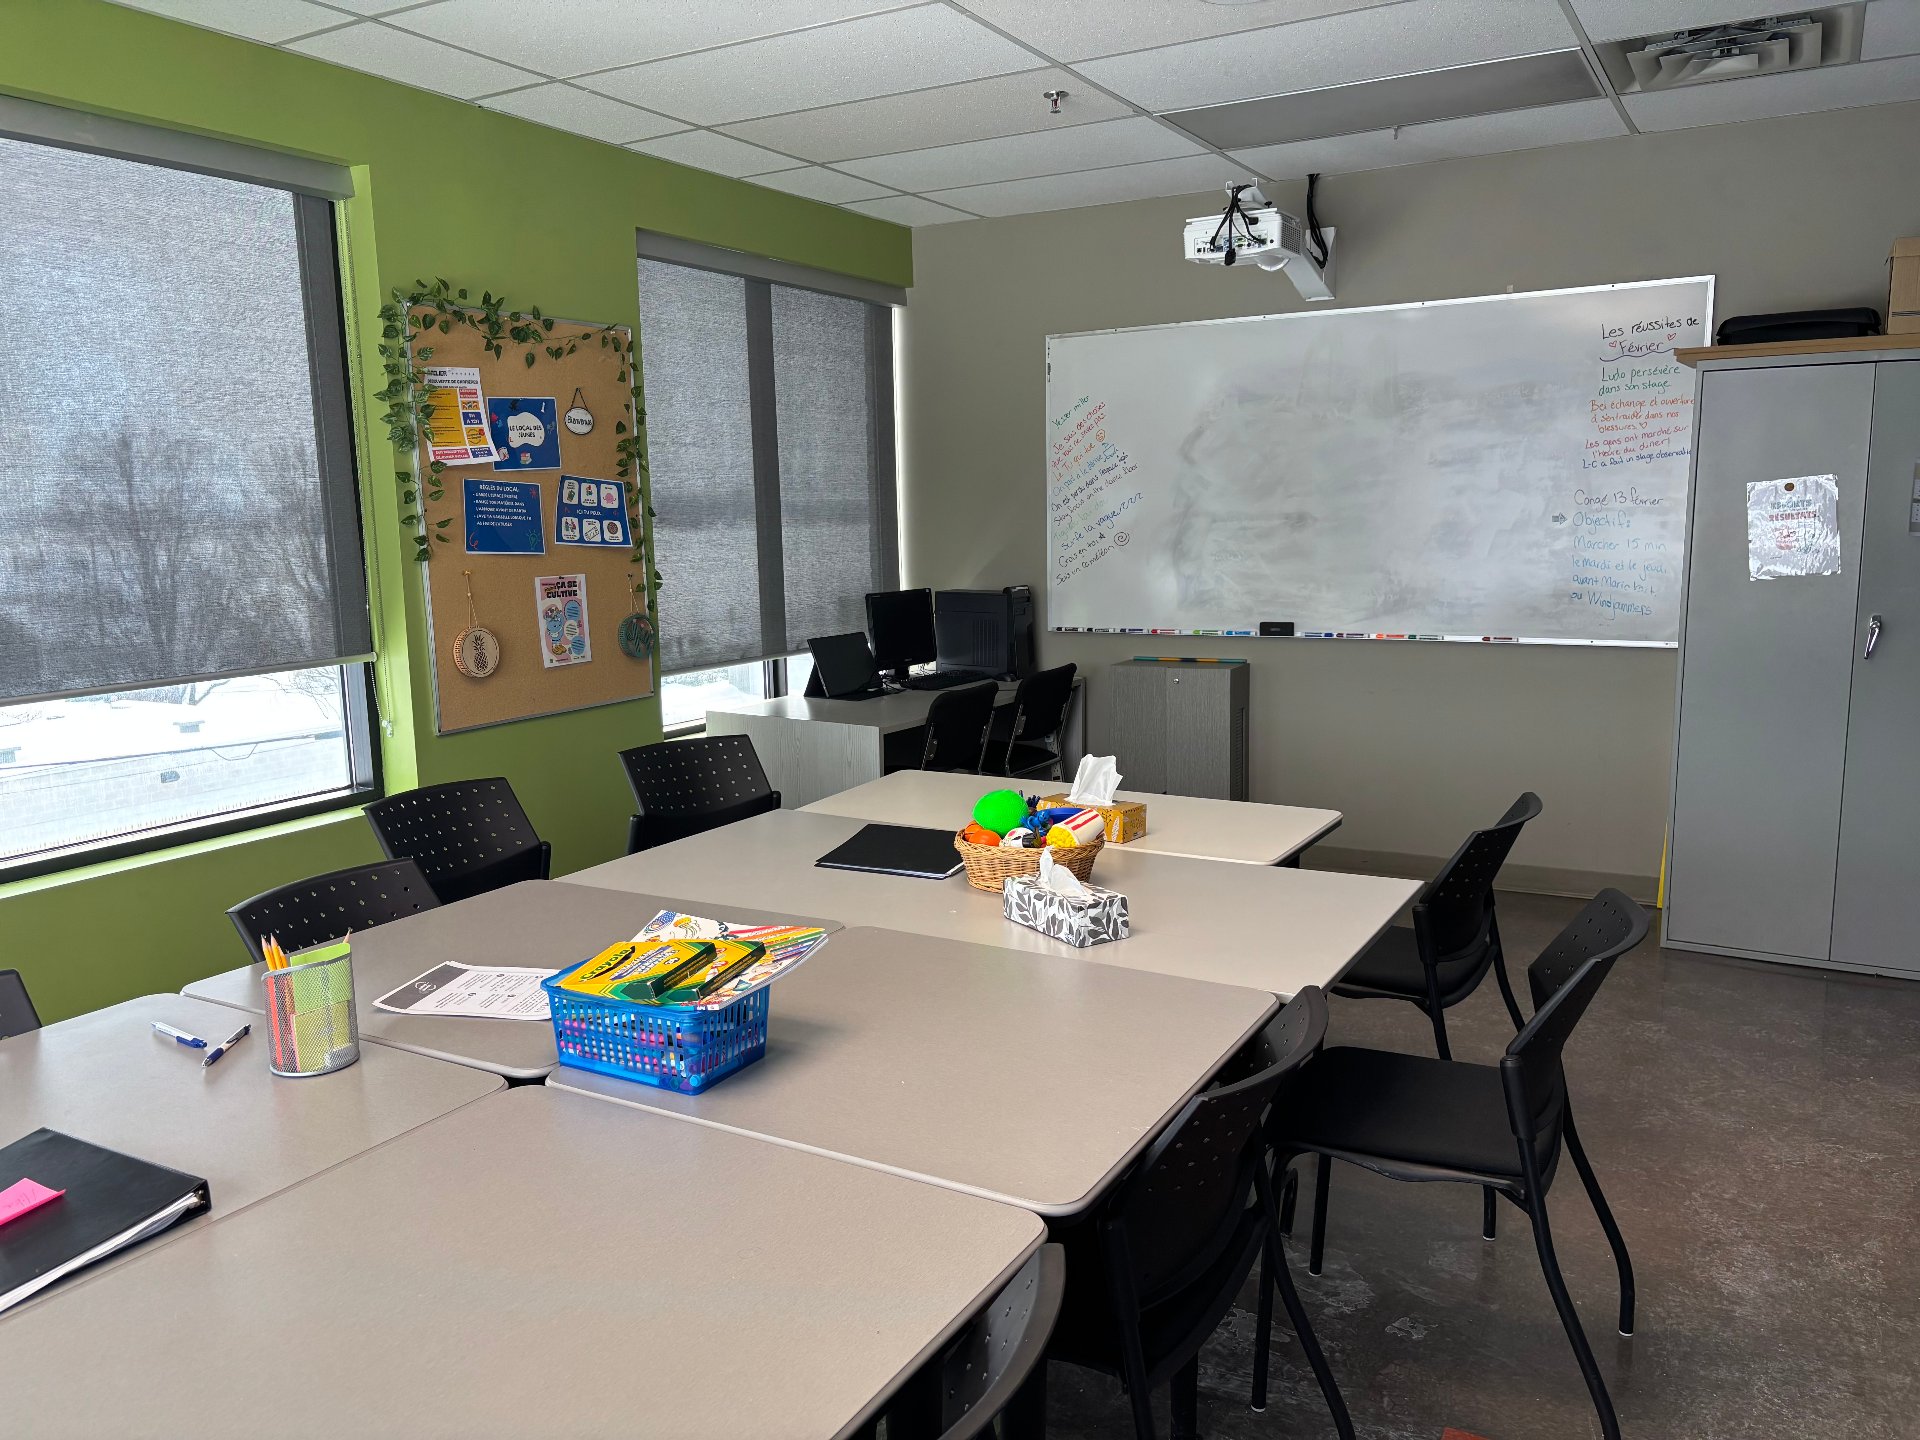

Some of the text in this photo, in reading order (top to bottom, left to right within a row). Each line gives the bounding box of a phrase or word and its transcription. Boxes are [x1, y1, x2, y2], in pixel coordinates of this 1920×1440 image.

[1601, 316, 1700, 340] Les réussites de
[1619, 339, 1664, 355] Février
[1601, 365, 1681, 384] Ludo persévère
[1598, 379, 1671, 397] dans son stage
[1644, 410, 1663, 420] dans
[1666, 411, 1680, 419] nos
[1585, 439, 1600, 450] Les
[1602, 439, 1622, 453] gens
[1623, 445, 1637, 454] du
[1573, 488, 1609, 512] Congé
[1613, 490, 1628, 504] 13
[1627, 537, 1641, 550] 15
[1644, 541, 1667, 553] min
[580, 947, 632, 982] Crayola
